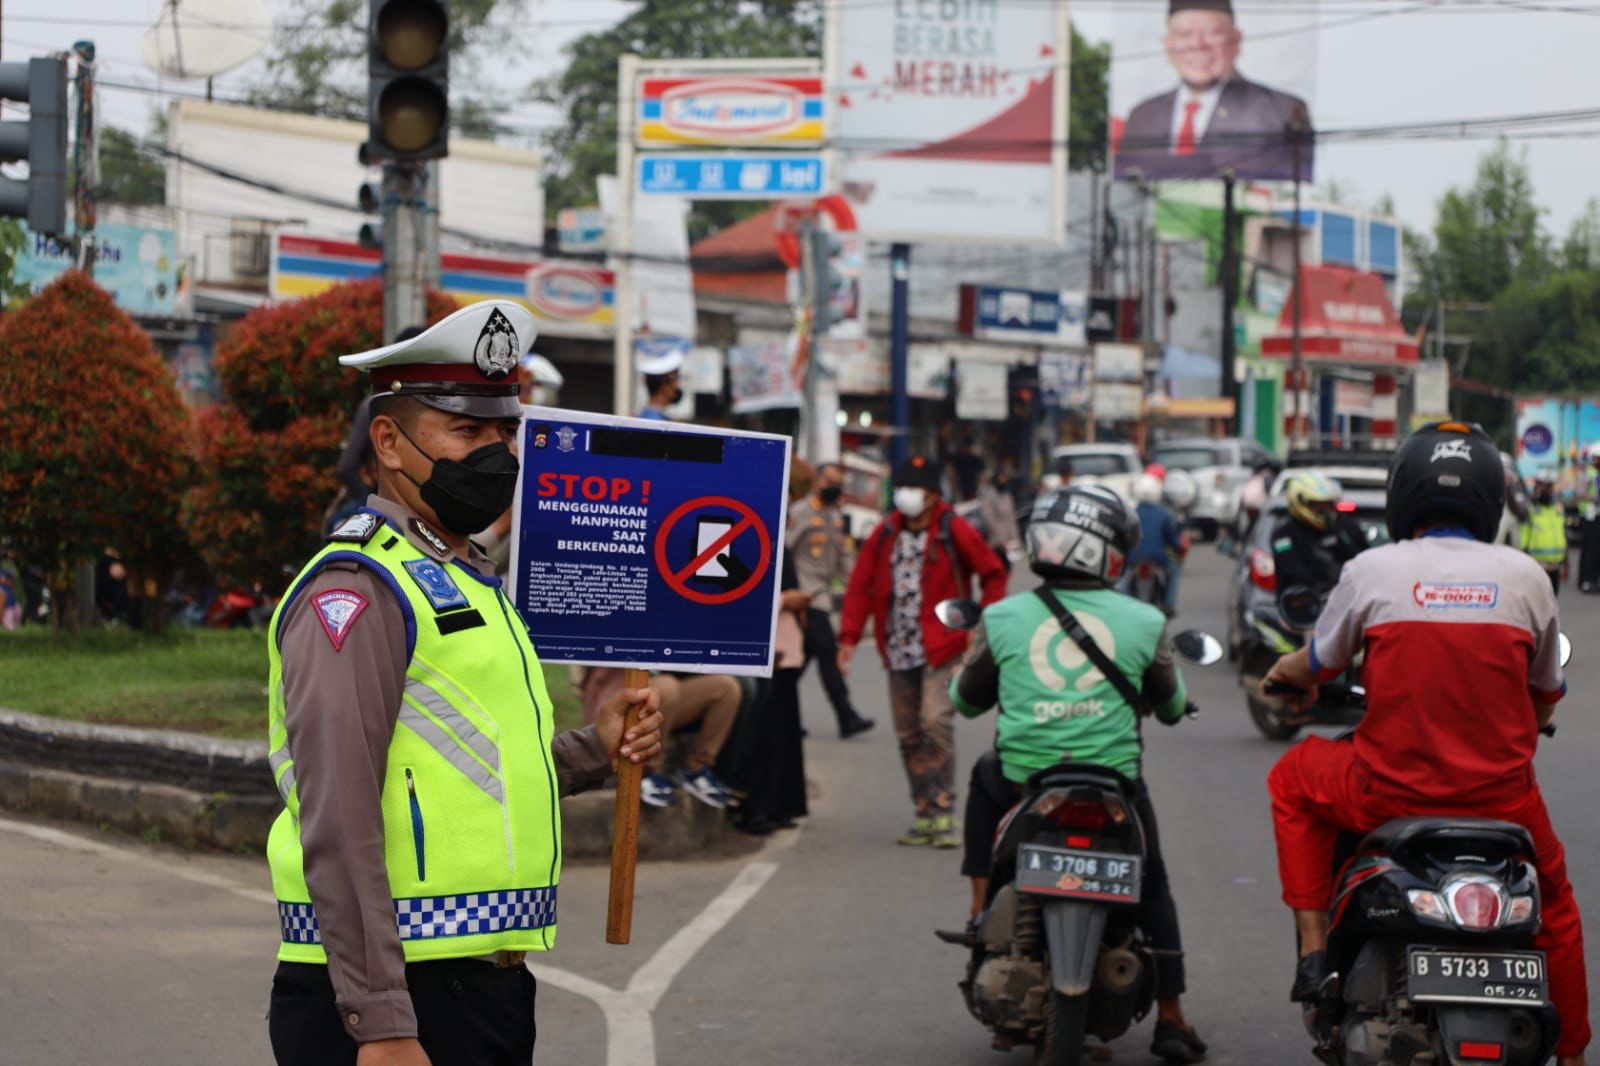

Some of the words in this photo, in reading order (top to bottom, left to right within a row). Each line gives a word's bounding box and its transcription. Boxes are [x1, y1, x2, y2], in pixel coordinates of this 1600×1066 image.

[894, 25, 995, 57] BERASA
[894, 60, 998, 97] MERAH
[536, 472, 632, 502] STOP
[640, 479, 651, 504] !
[538, 500, 648, 517] MENGGUNAKAN
[571, 515, 647, 529] HANPHONE
[557, 540, 645, 555] BERKENDARA
[612, 530, 647, 542] SAAT
[1032, 698, 1106, 723] gojek
[1029, 853, 1041, 870] A
[1052, 855, 1098, 876] 3706
[1107, 861, 1131, 879] DF
[1416, 956, 1429, 976] B
[1440, 957, 1490, 978] 5733
[1502, 959, 1539, 980] TCD
